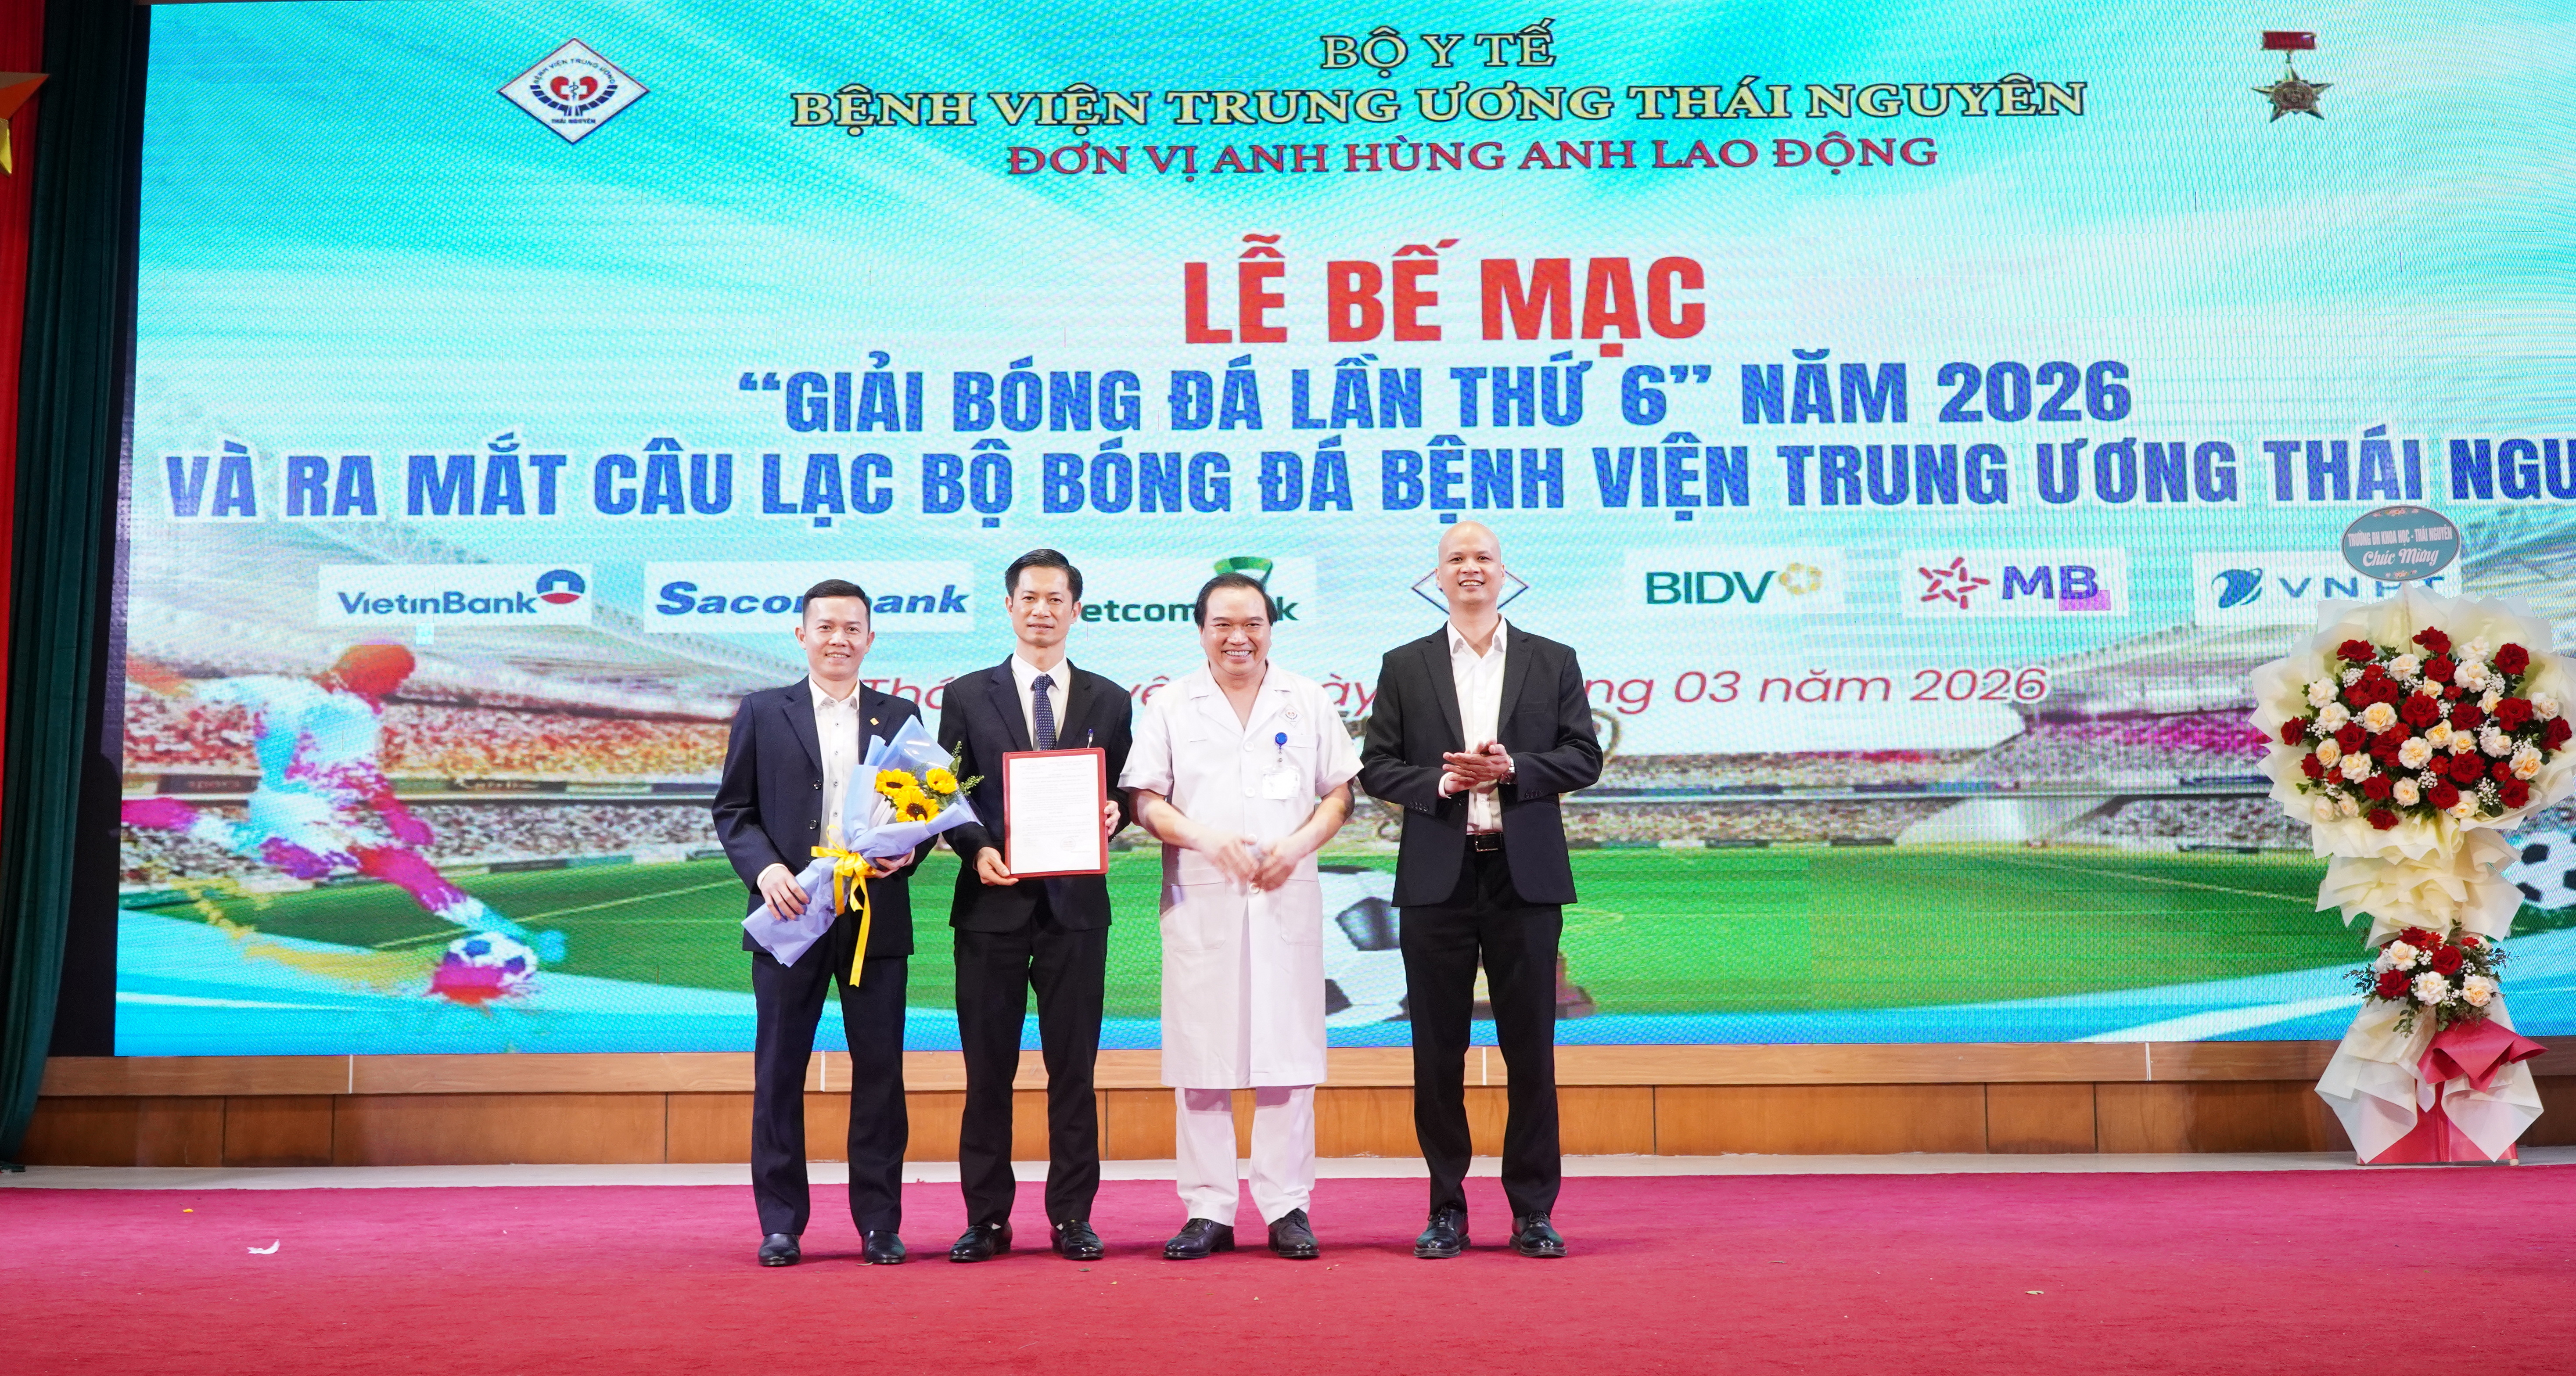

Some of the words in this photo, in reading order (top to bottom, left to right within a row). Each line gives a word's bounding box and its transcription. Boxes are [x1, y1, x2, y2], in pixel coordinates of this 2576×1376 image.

[1320, 25, 1408, 78] BỘ
[1420, 34, 1465, 68] Y
[1474, 18, 1556, 67] TẾ
[790, 83, 977, 137] BỆNH
[987, 83, 1152, 136] VIỆN
[1164, 89, 1401, 125] TRUNG
[1414, 81, 1614, 122] ƯƠNG
[1627, 75, 1792, 119] THÁI
[1805, 73, 2087, 118] NGUYÊN
[1008, 140, 1129, 175] ĐƠN
[1144, 146, 1197, 182] VỊ
[1212, 144, 1328, 173] ANH
[1346, 142, 1506, 173] HÙNG
[1519, 140, 1636, 170] ANH
[1654, 139, 1760, 168] LAO
[1774, 131, 1939, 174] ĐỘNG
[1185, 234, 1286, 343] LỄ
[1328, 239, 1459, 342] BẾ
[1481, 257, 1705, 357] MẠC
[954, 356, 1140, 431] BÓNG
[1168, 354, 1262, 430] ĐÁ
[1293, 354, 1421, 428] LẦN
[1451, 350, 1592, 426] THỨ
[1742, 349, 1907, 424] NĂM
[1938, 361, 2130, 422] 2026
[167, 441, 255, 516] VÀ
[288, 456, 376, 515] RA
[408, 433, 566, 515] MẮT
[595, 438, 732, 514] CÂU
[763, 453, 892, 527] LẠC
[923, 439, 1012, 527] BỘ
[1044, 437, 1230, 513] BÓNG
[1258, 435, 1352, 511] ĐÁ
[1382, 435, 1563, 523] BỆNH
[1592, 432, 1749, 521] VIỆN
[1778, 444, 2007, 505] TRUNG
[2037, 438, 2237, 503] ƯƠNG
[2264, 424, 2422, 500] THÁI
[2450, 438, 2576, 499] NGU
[2381, 530, 2397, 544] KHOA
[2398, 529, 2410, 546] HỌC
[2414, 525, 2428, 542] THÁI
[2363, 550, 2395, 567] Chúc
[2398, 548, 2439, 566] Mừng
[657, 581, 969, 614] Sacoank
[1646, 571, 1777, 604] BIDV
[2001, 565, 2100, 600] MB
[338, 591, 536, 614] VietinBank
[1081, 596, 1298, 622] etcomk
[862, 677, 954, 710] Thá
[1674, 671, 1741, 703] 03
[1760, 669, 1890, 702] năm
[1911, 668, 2046, 701] 2026
